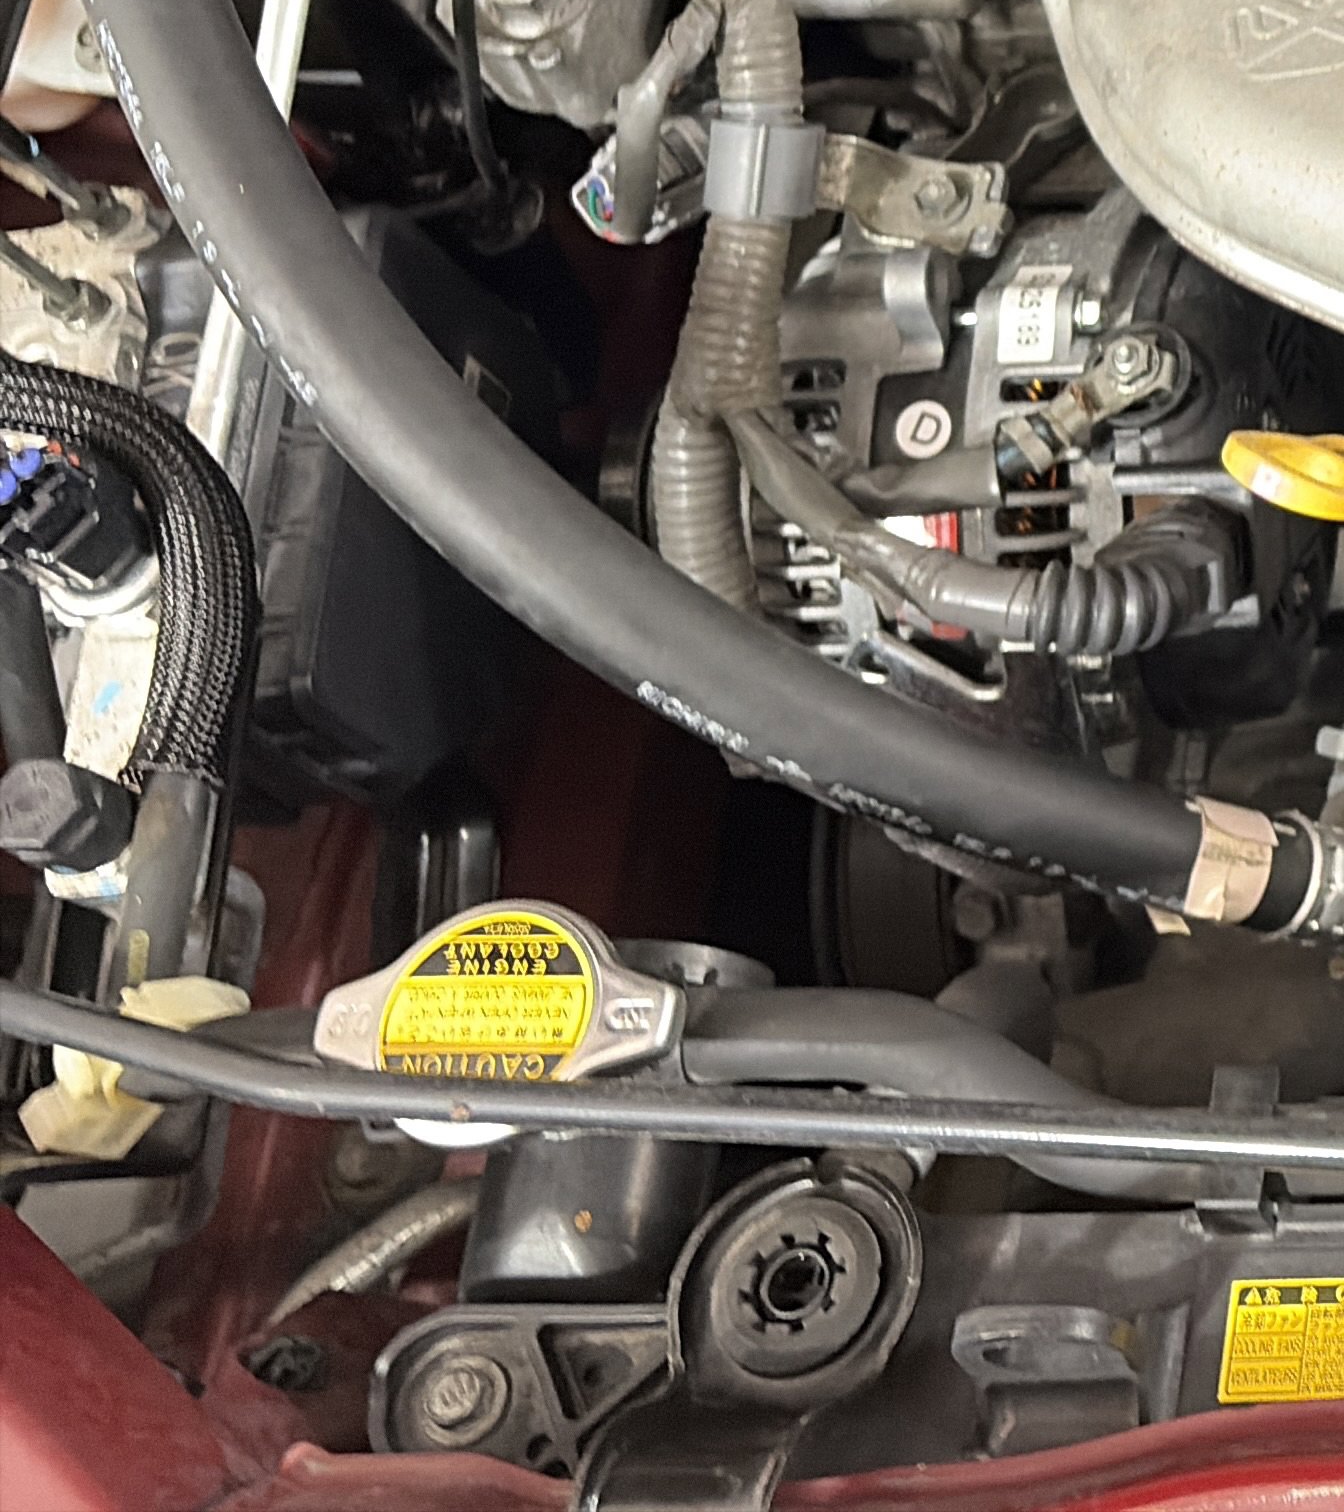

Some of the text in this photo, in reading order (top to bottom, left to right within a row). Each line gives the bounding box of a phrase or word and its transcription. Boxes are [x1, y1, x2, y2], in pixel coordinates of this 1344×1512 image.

[910, 410, 943, 446] D
[443, 942, 560, 960] COOLANT
[446, 958, 548, 976] ENGINE
[401, 1052, 545, 1080] CAUTION
